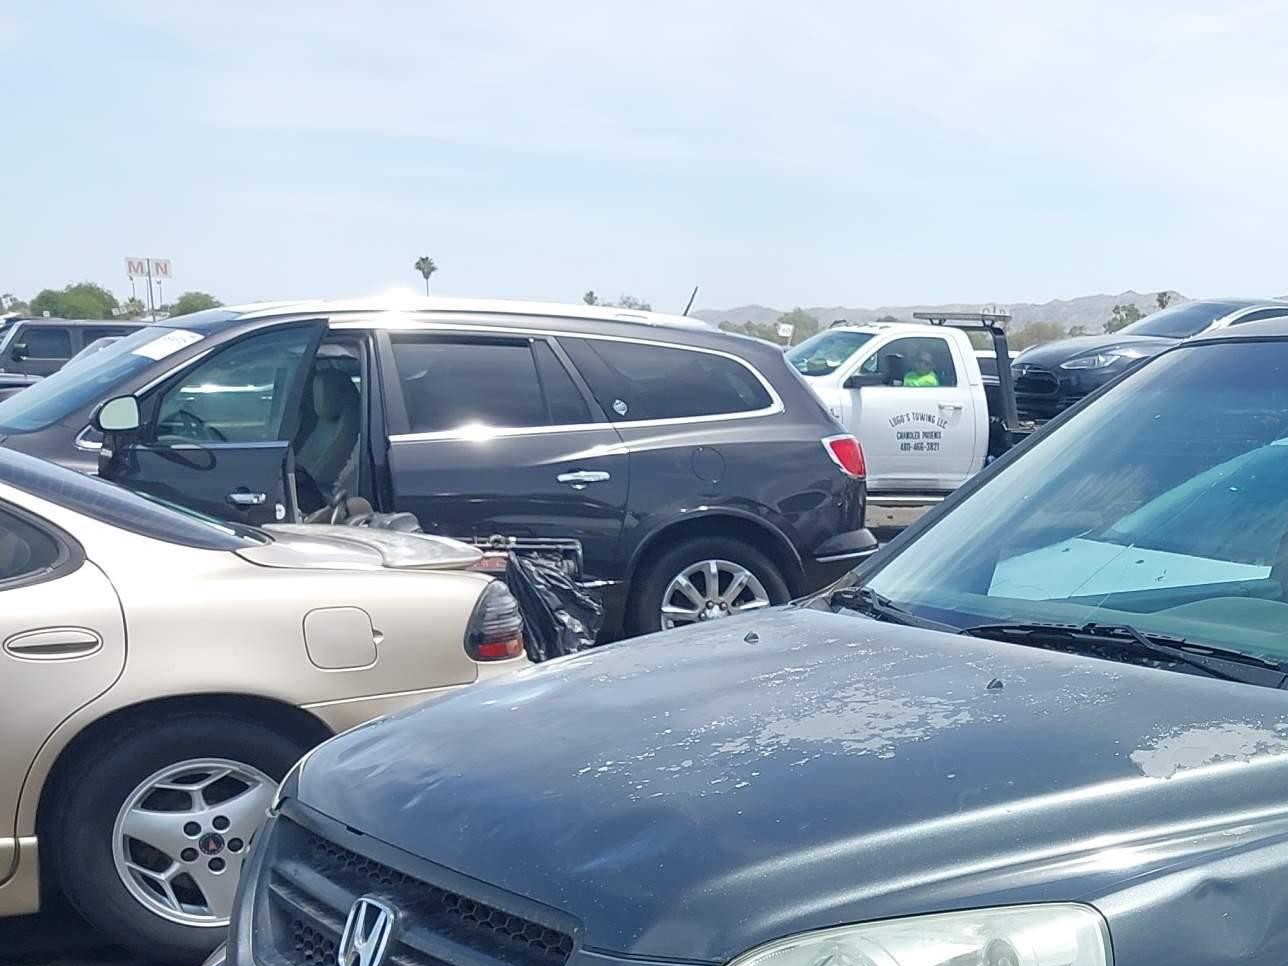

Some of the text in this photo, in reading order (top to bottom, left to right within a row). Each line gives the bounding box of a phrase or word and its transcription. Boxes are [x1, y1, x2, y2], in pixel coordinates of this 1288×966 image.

[911, 411, 936, 424] TOWING
[936, 417, 948, 429] LLC
[896, 431, 942, 440] CHANDLER PHOENIX
